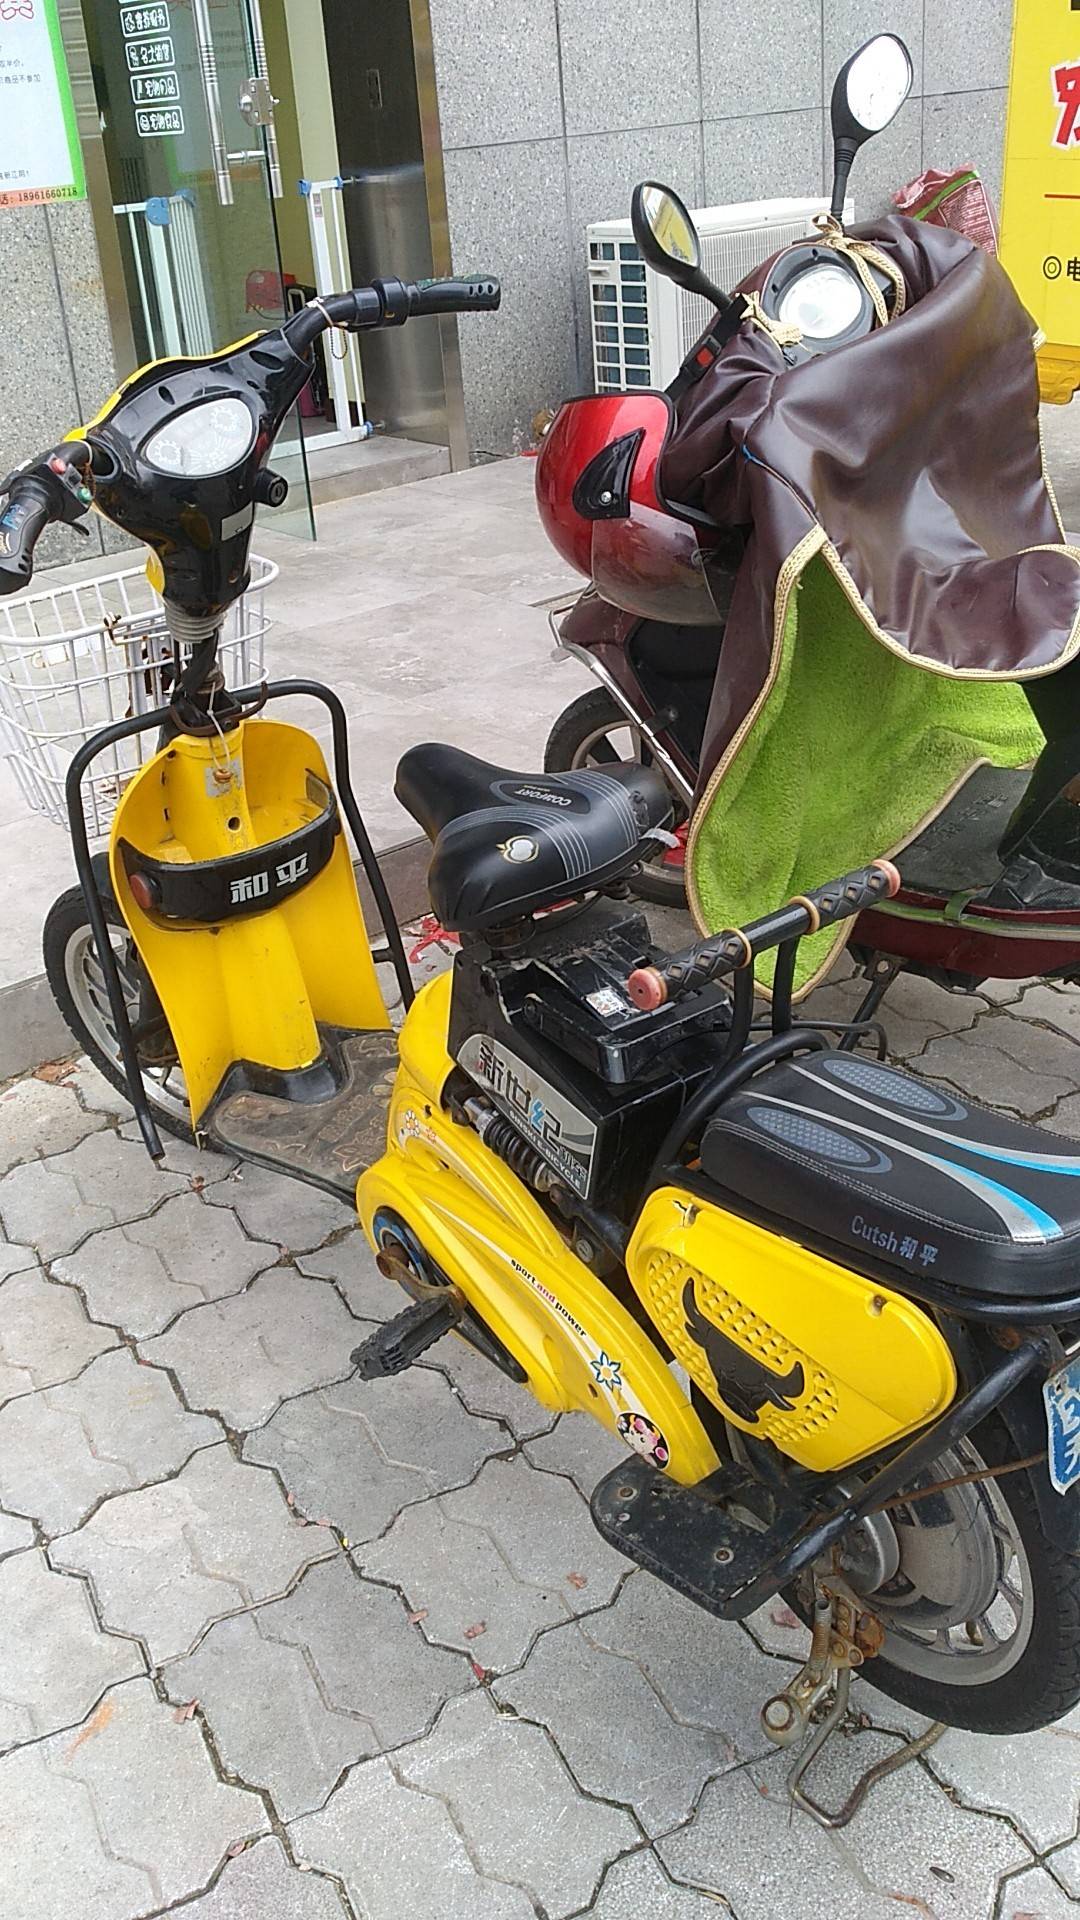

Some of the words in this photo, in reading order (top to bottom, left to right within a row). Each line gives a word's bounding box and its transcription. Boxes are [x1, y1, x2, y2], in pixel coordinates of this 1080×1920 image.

[145, 76, 175, 97] 宠物用品
[150, 111, 180, 131] 宠物食品
[230, 852, 309, 904] 和平
[477, 1040, 561, 1154] 新世纪
